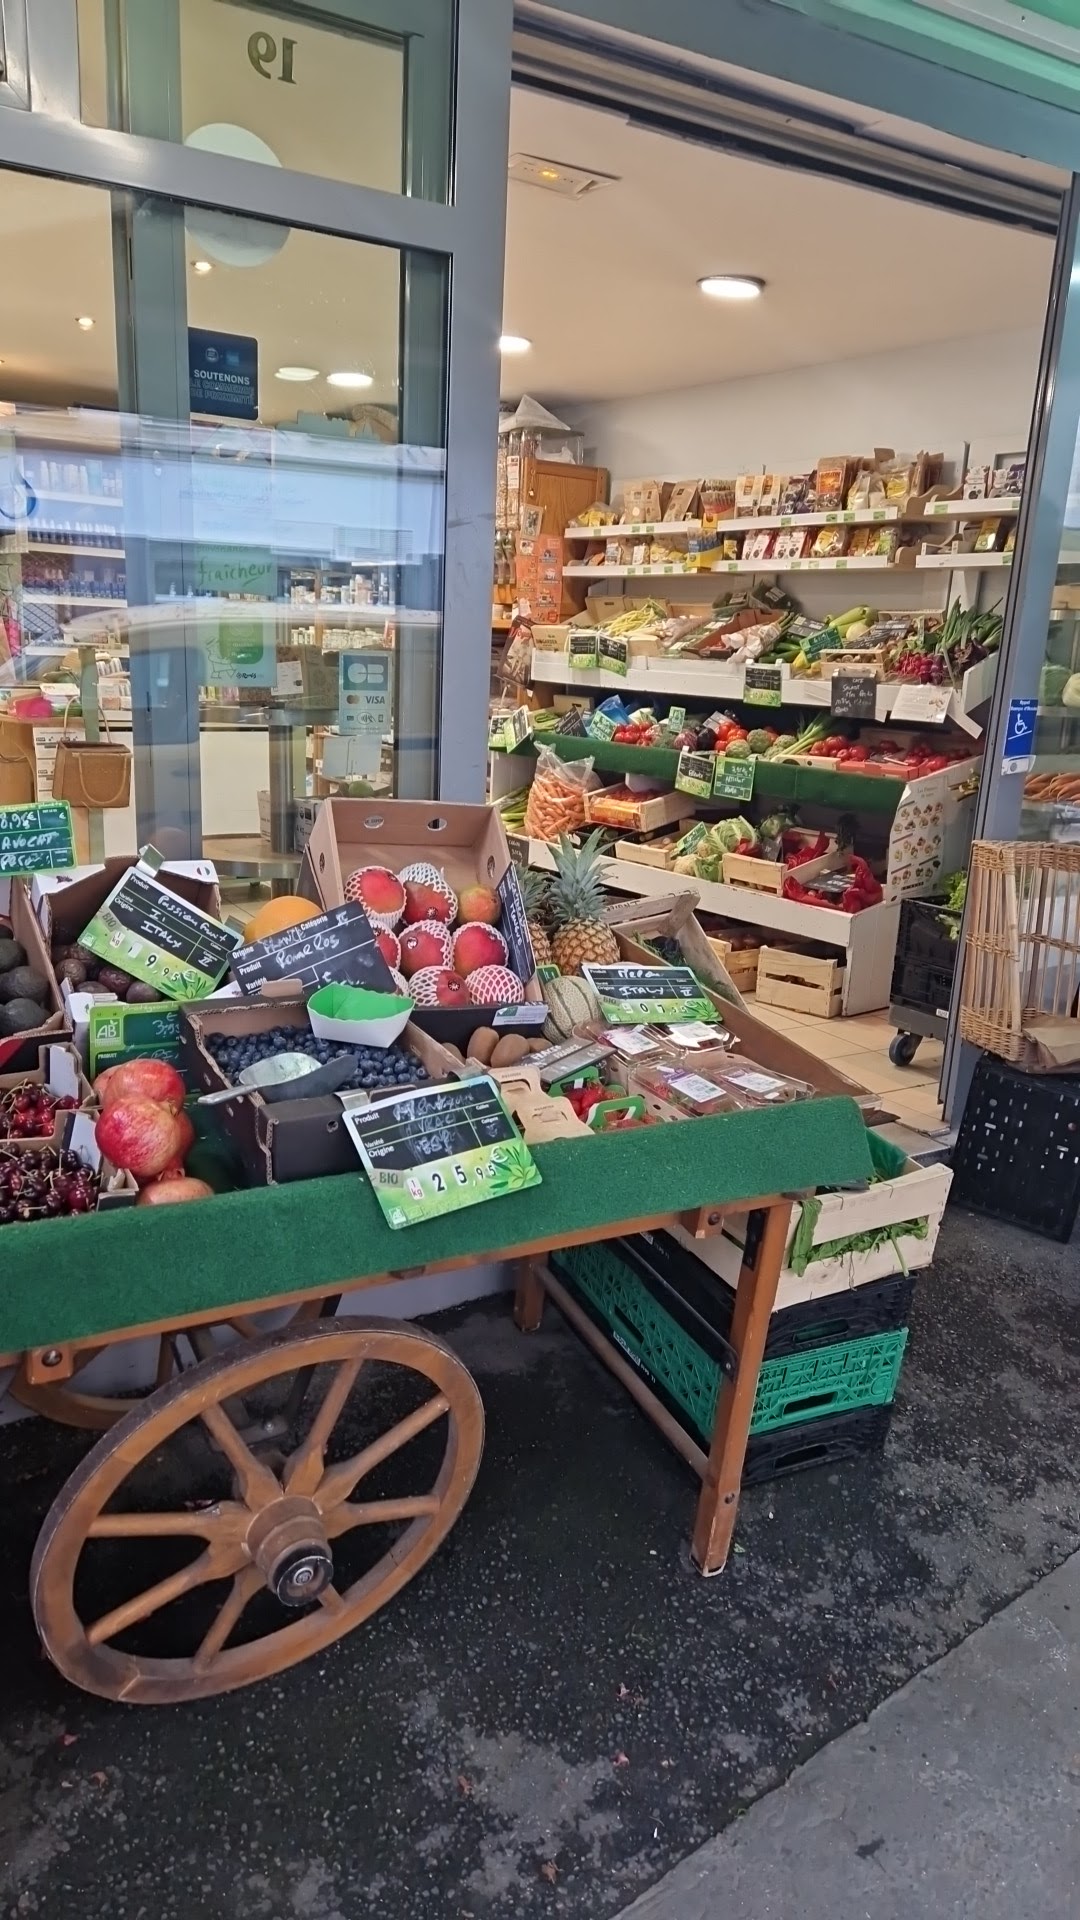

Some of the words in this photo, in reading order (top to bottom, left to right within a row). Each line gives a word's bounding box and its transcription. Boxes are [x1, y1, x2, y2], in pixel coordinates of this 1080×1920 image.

[193, 369, 250, 386] SOUTENONS
[365, 695, 385, 705] VISA
[2, 831, 60, 850] AVOCAT
[129, 875, 150, 891] Produit
[102, 912, 117, 929] BIO
[114, 897, 134, 912] Origine
[140, 920, 183, 949] ITALY
[300, 914, 328, 931] Catégorie
[232, 946, 255, 960] Origine
[239, 961, 262, 976] Produit
[619, 985, 664, 997] ITALY
[97, 1024, 117, 1038] AB
[354, 1112, 380, 1125] Produit
[368, 1145, 395, 1159] Origine
[379, 1172, 399, 1185] BIO
[411, 1188, 423, 1198] kg
